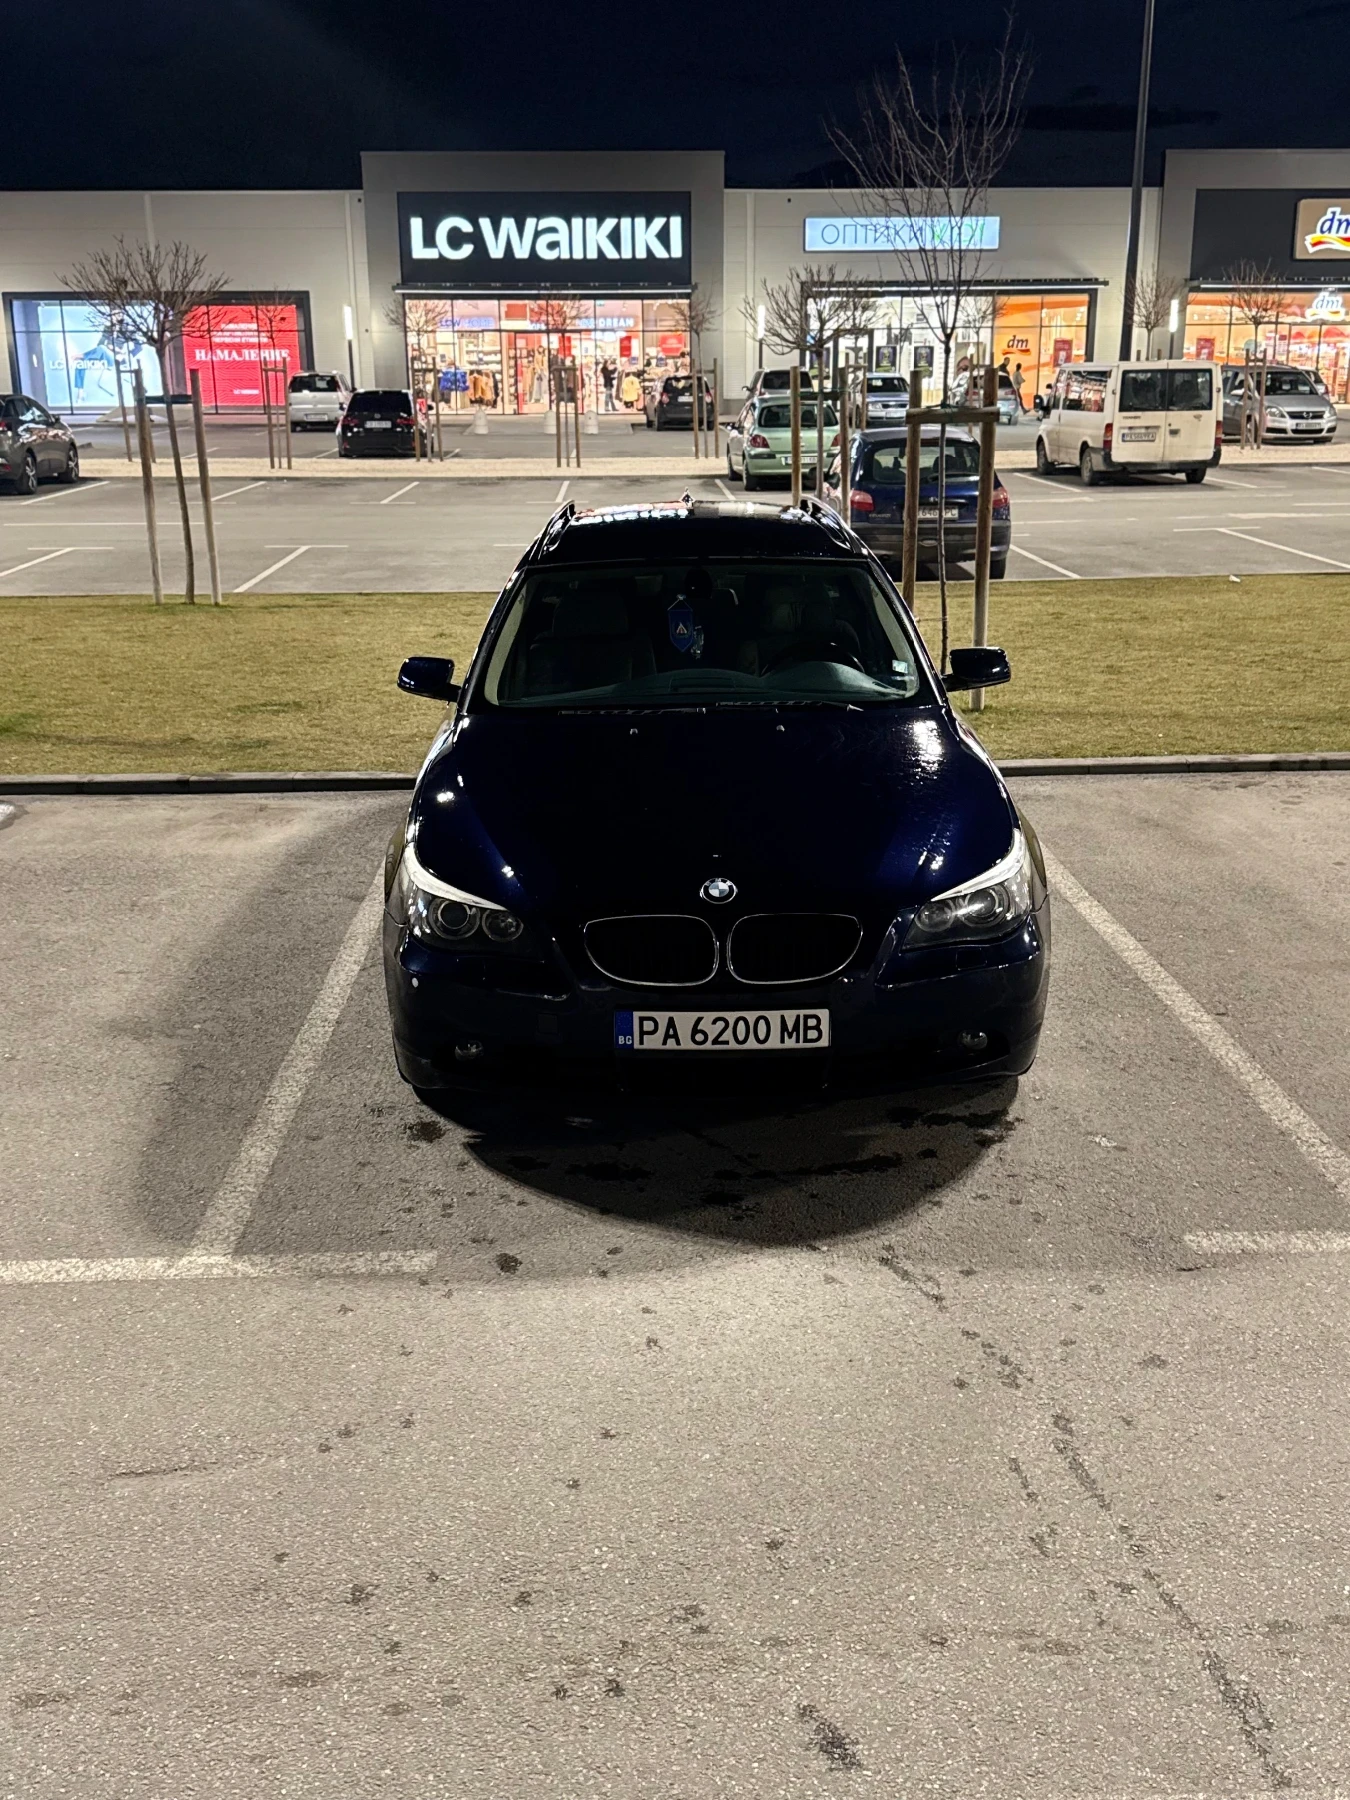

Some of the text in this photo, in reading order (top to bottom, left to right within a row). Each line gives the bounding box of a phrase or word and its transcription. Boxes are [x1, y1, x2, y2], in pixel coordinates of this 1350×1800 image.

[410, 216, 474, 260] LC
[1316, 296, 1340, 310] dm
[1007, 335, 1029, 349] dm
[195, 349, 291, 361] НАМАЛЕНИЕ
[638, 1014, 823, 1046] PA 6200 MB
[618, 1035, 633, 1045] BG
